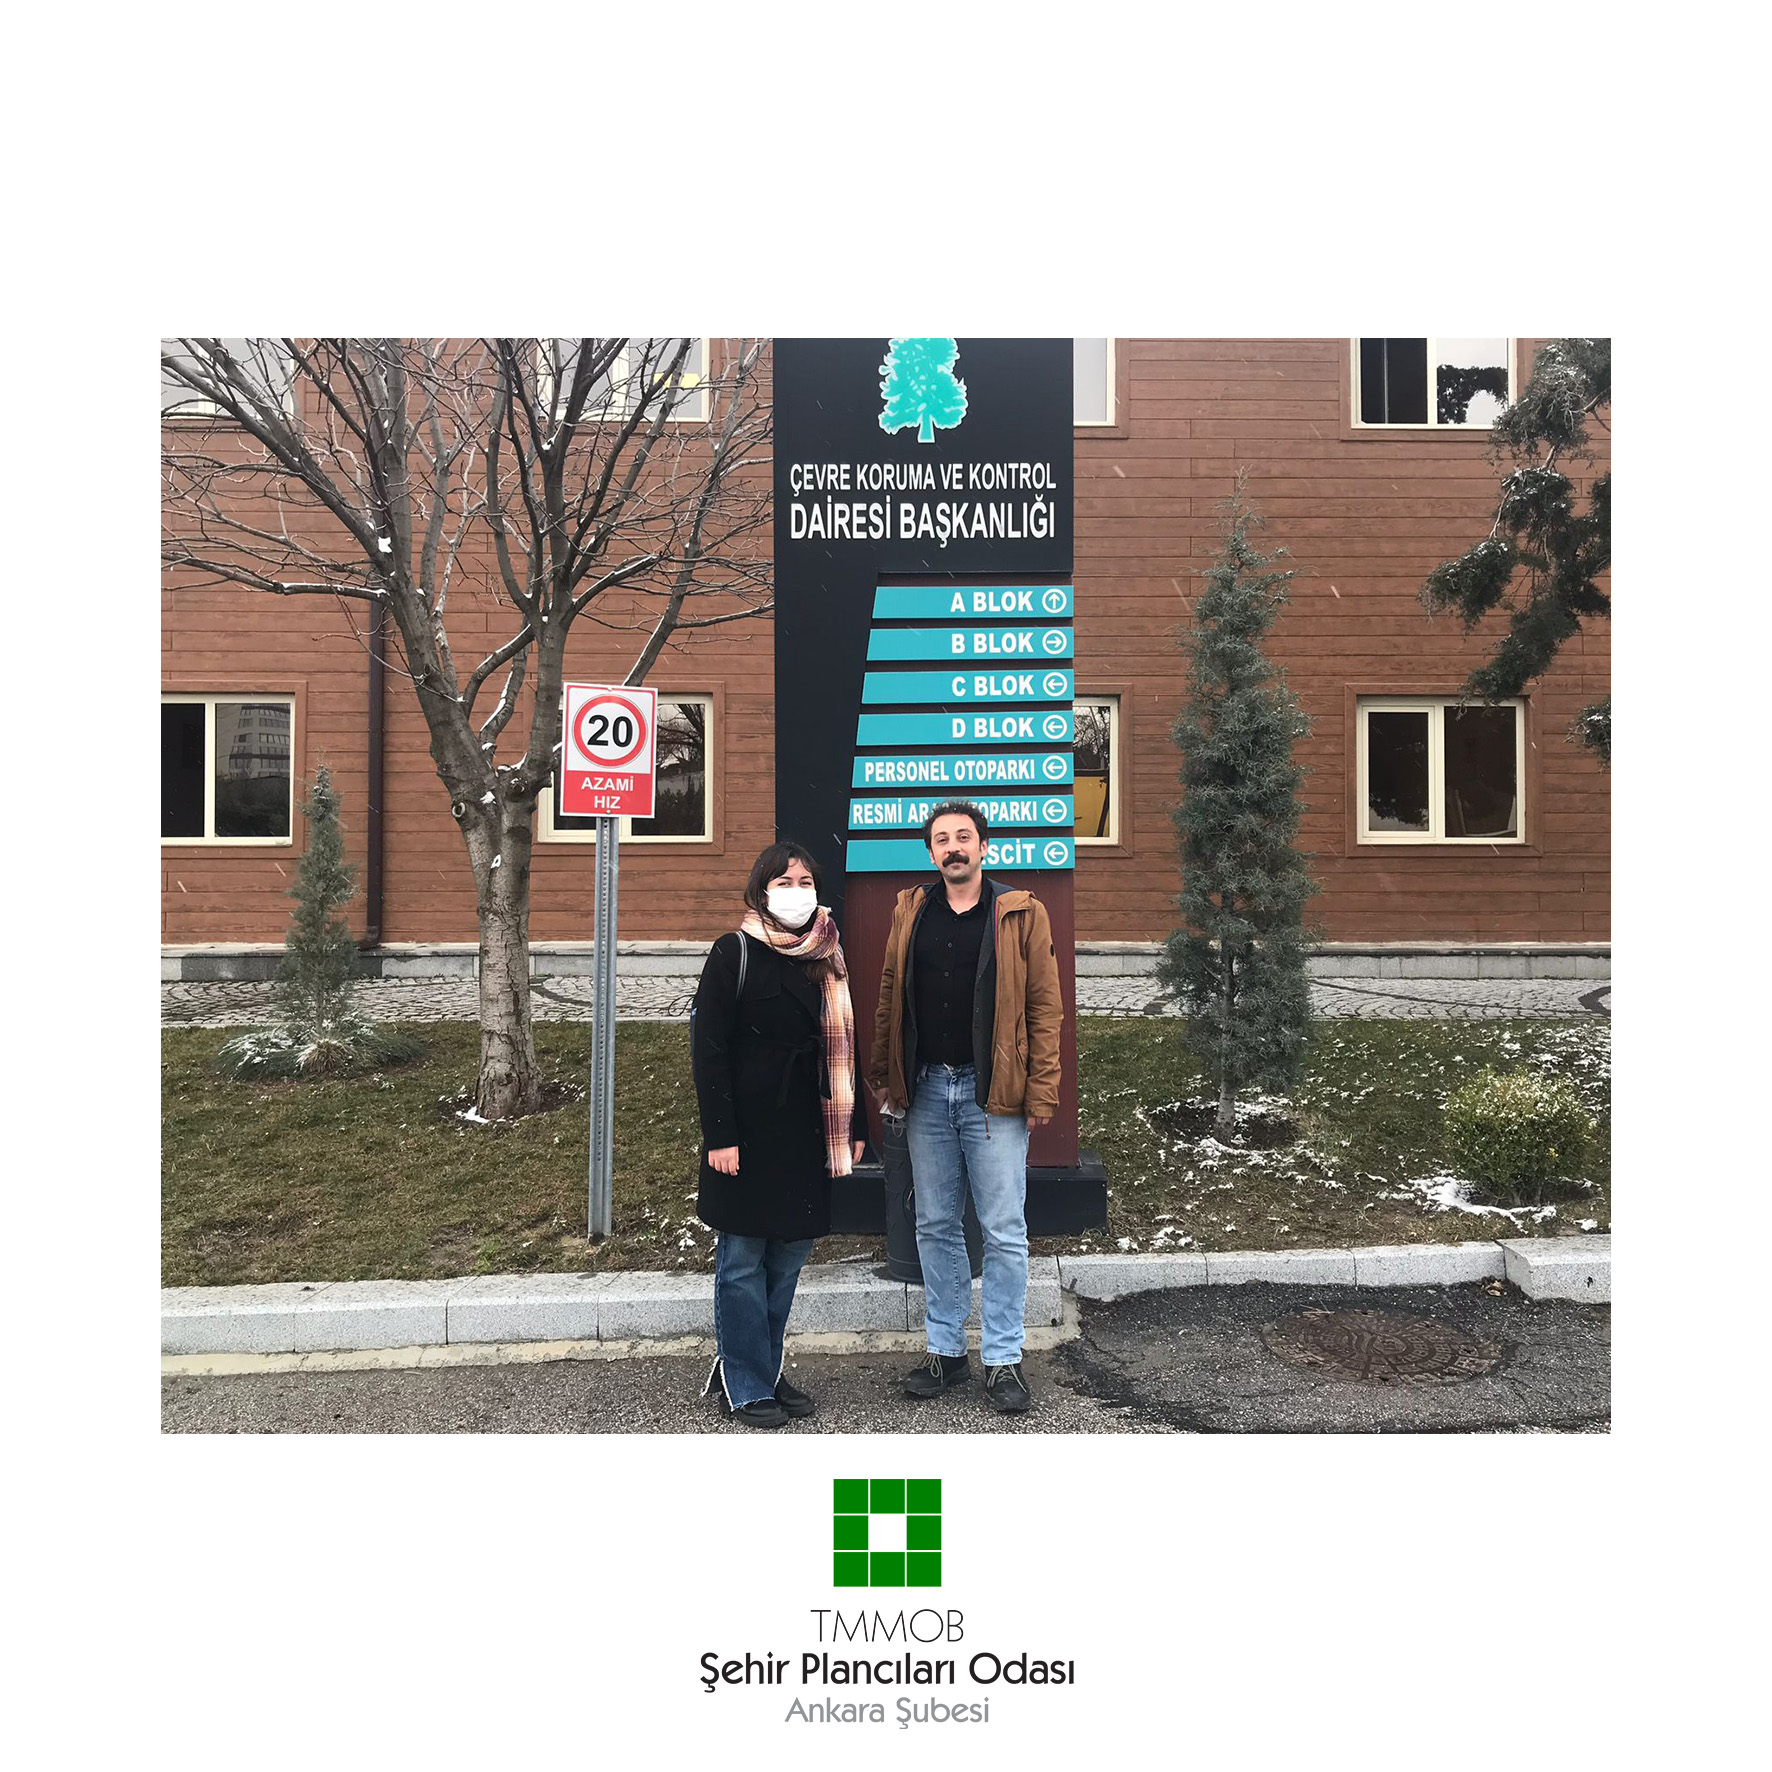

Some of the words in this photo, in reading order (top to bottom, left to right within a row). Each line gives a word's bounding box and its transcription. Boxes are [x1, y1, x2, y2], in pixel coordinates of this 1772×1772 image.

[790, 463, 851, 497] ÇEVRE
[856, 463, 936, 490] KORUMA
[939, 463, 964, 490] VE
[969, 462, 1057, 490] KONTROL
[790, 494, 892, 539] DAİRESİ
[899, 493, 1056, 549] BAŞKANLIĞI
[950, 591, 966, 613] A
[973, 590, 1034, 612] BLOK
[951, 633, 966, 654] B
[973, 632, 1034, 653] BLOK
[951, 676, 967, 697] C
[974, 674, 1035, 696] BLOK
[586, 714, 634, 748] 20
[952, 717, 967, 739] D
[974, 716, 1035, 738] BLOK
[864, 761, 950, 783] PERSONEL
[954, 759, 1036, 781] OTOPARKI
[580, 775, 635, 792] AZAMİ
[593, 795, 622, 809] HIZ
[852, 798, 903, 825] RESMİ
[968, 801, 1038, 822] OPARKI
[981, 838, 1036, 865] SCİT
